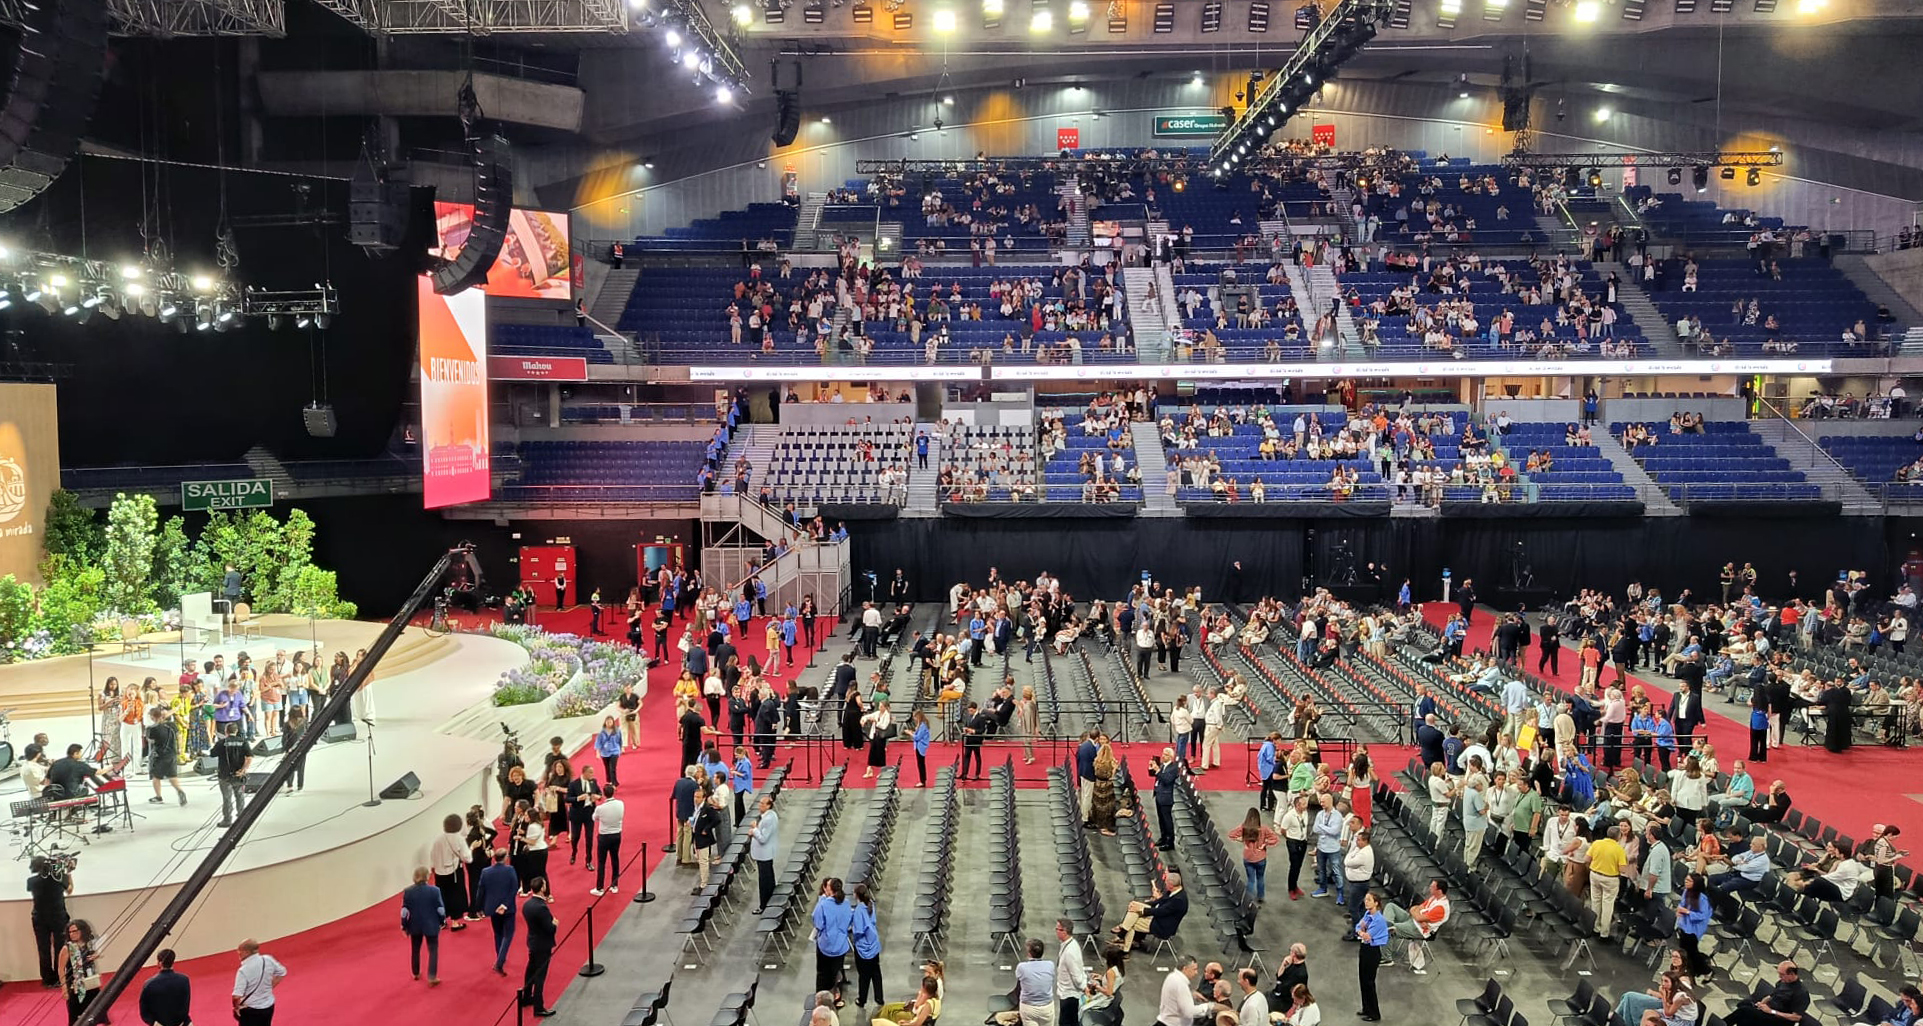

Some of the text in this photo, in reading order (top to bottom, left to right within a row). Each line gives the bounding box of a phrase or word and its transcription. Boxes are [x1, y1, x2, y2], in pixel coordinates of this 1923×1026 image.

[1168, 119, 1195, 129] caser
[430, 356, 480, 385] BIENVENIDOS
[522, 361, 552, 370] Mahou
[187, 482, 266, 497] SALIDA
[210, 496, 245, 507] EXIT
[5, 521, 33, 537] mirada
